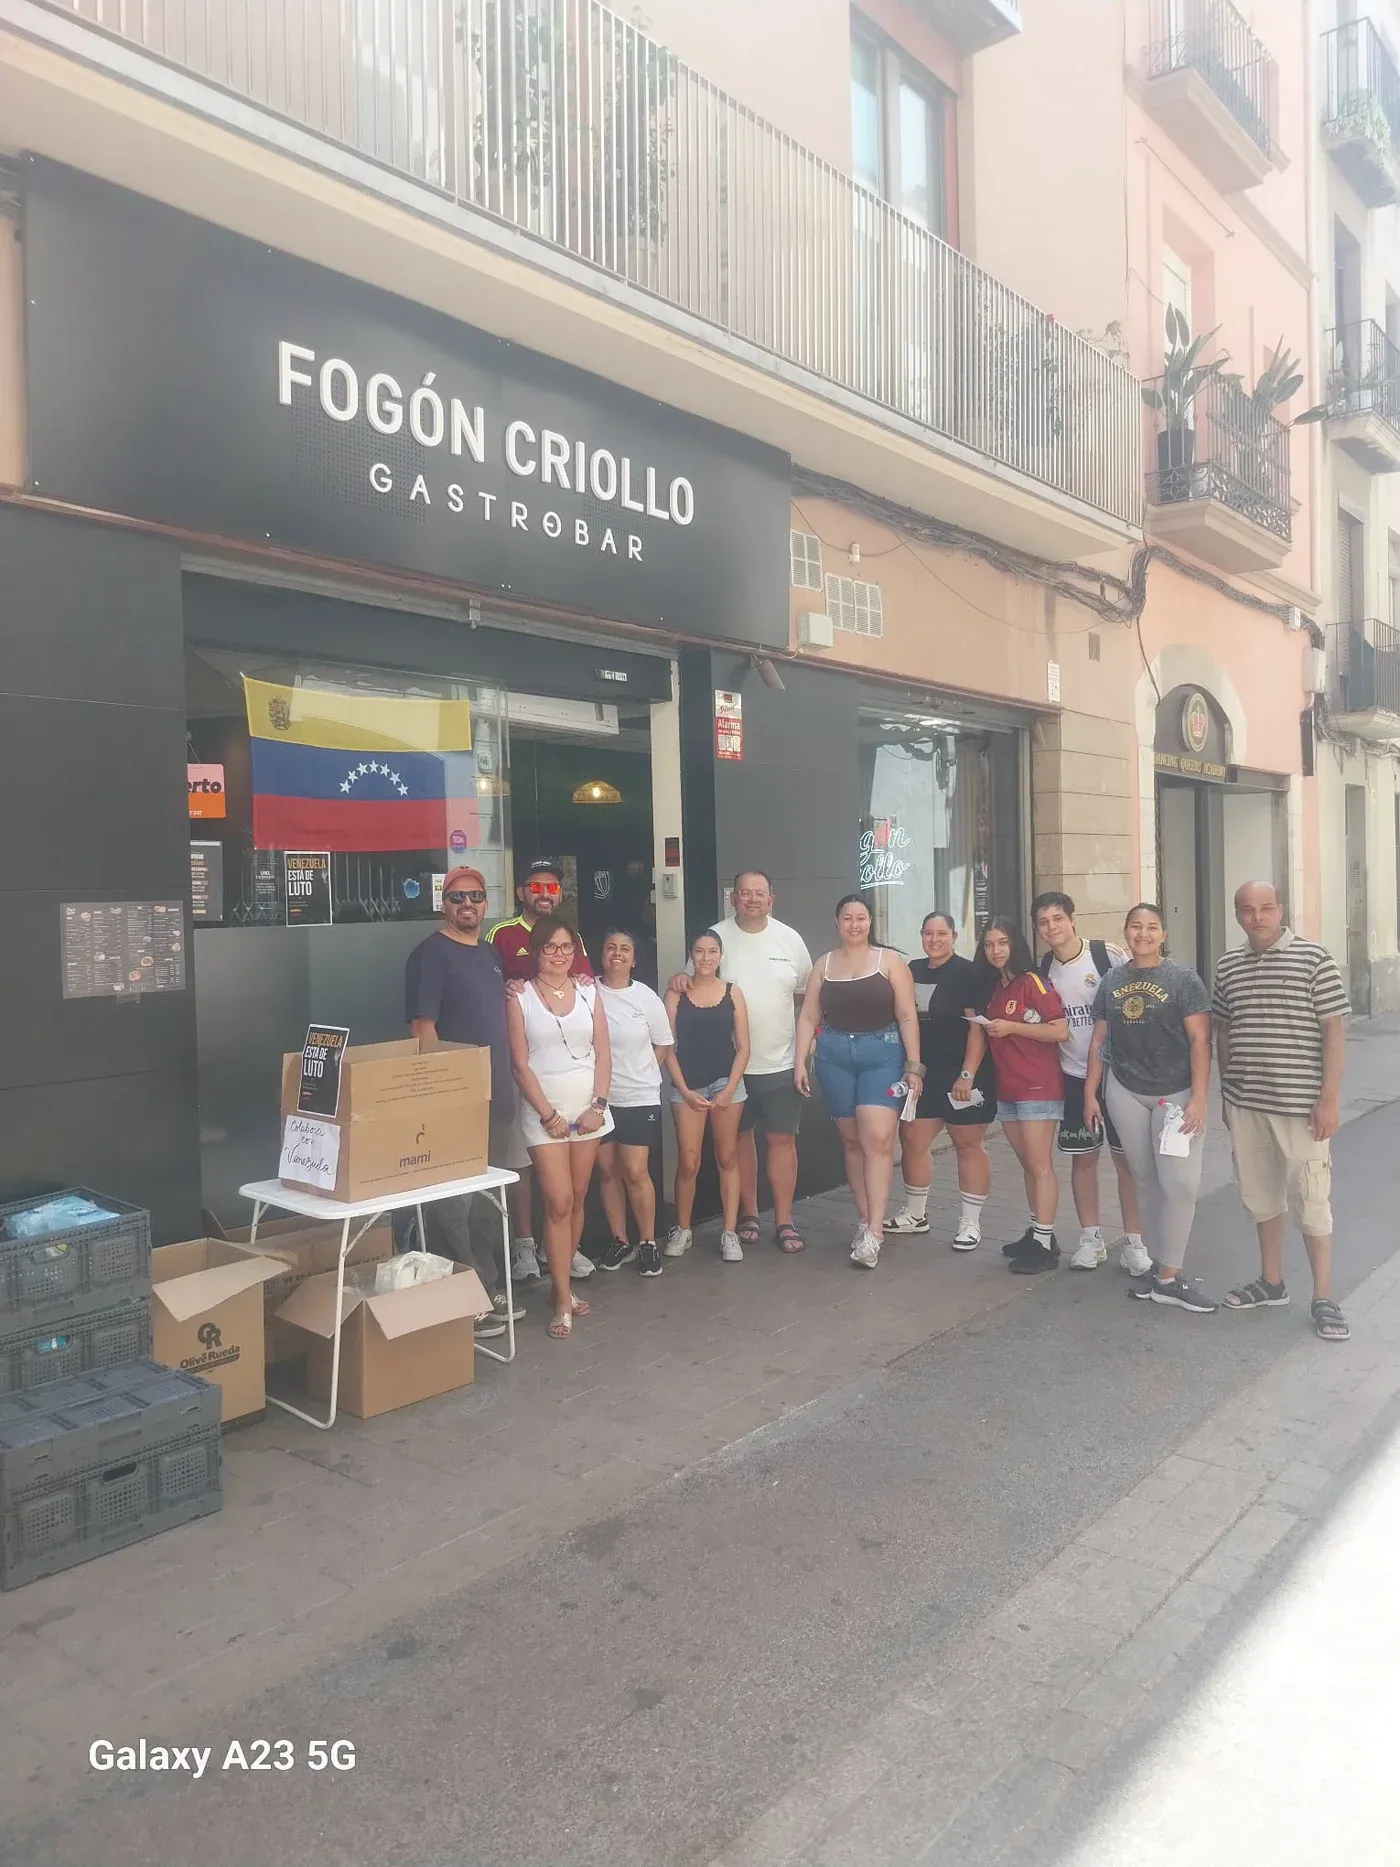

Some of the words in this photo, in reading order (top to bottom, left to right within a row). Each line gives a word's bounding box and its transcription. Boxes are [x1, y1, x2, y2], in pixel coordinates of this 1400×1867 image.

[278, 340, 486, 463] FOGÓN
[505, 420, 695, 526] CRIOLLO
[369, 463, 643, 562] GASTROBAR
[717, 718, 741, 731] Alarma
[287, 857, 326, 869] VENEZUELA
[305, 869, 314, 881] DE
[288, 881, 312, 896] LUTO
[308, 1031, 343, 1048] VENEZUELA
[319, 1047, 328, 1060] DE
[303, 1059, 324, 1078] LUTO
[284, 1142, 334, 1176] Venezuela
[399, 1150, 431, 1168] mami
